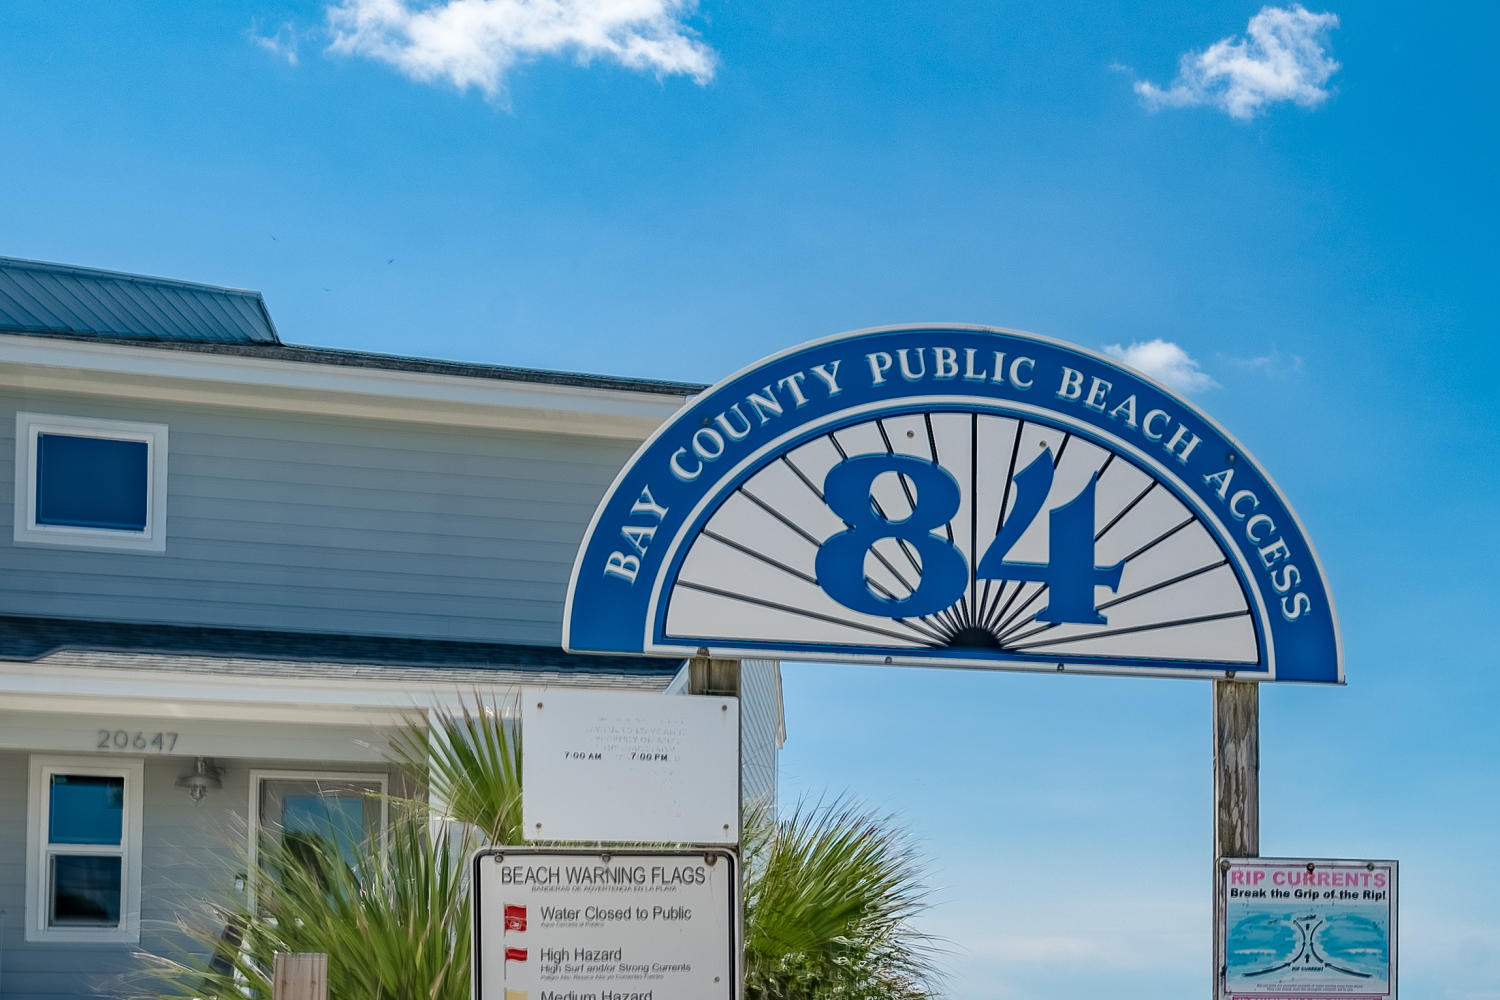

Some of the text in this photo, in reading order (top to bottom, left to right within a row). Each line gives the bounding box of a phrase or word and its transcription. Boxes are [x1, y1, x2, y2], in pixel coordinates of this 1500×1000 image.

[603, 347, 1312, 622] BAY COUNTY PUBLIC BEACH ACCESS
[815, 448, 1127, 626] 84
[96, 730, 179, 752] 20647
[588, 752, 602, 761] AM
[654, 753, 668, 761] PM
[501, 866, 706, 885] BEACH WARNING FLAGS
[1231, 870, 1386, 888] RIP CURRENTS
[1230, 888, 1386, 902] Break the Grip of the Rip!
[540, 905, 692, 920] Water Closed to Public
[540, 947, 622, 965] High Hazard
[540, 962, 691, 974] High Surf and/or Strong Currents
